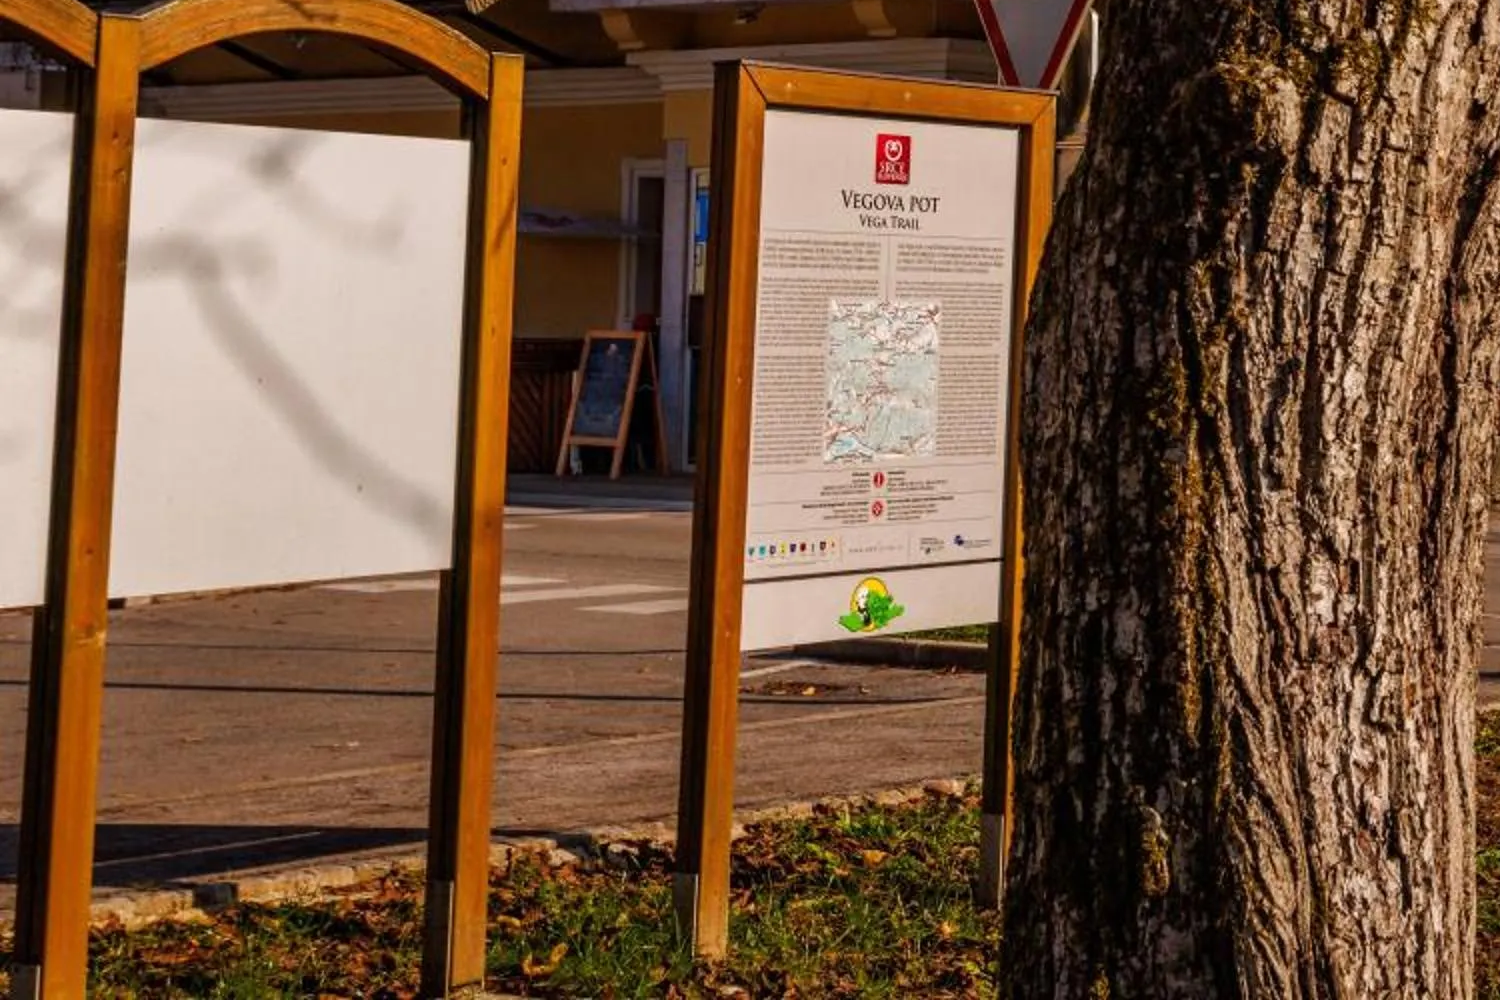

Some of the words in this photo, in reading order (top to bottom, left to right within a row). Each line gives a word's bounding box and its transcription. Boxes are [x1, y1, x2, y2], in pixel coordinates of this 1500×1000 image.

[841, 189, 905, 212] VEGOVA
[909, 196, 941, 213] POT
[859, 214, 887, 229] VEGA
